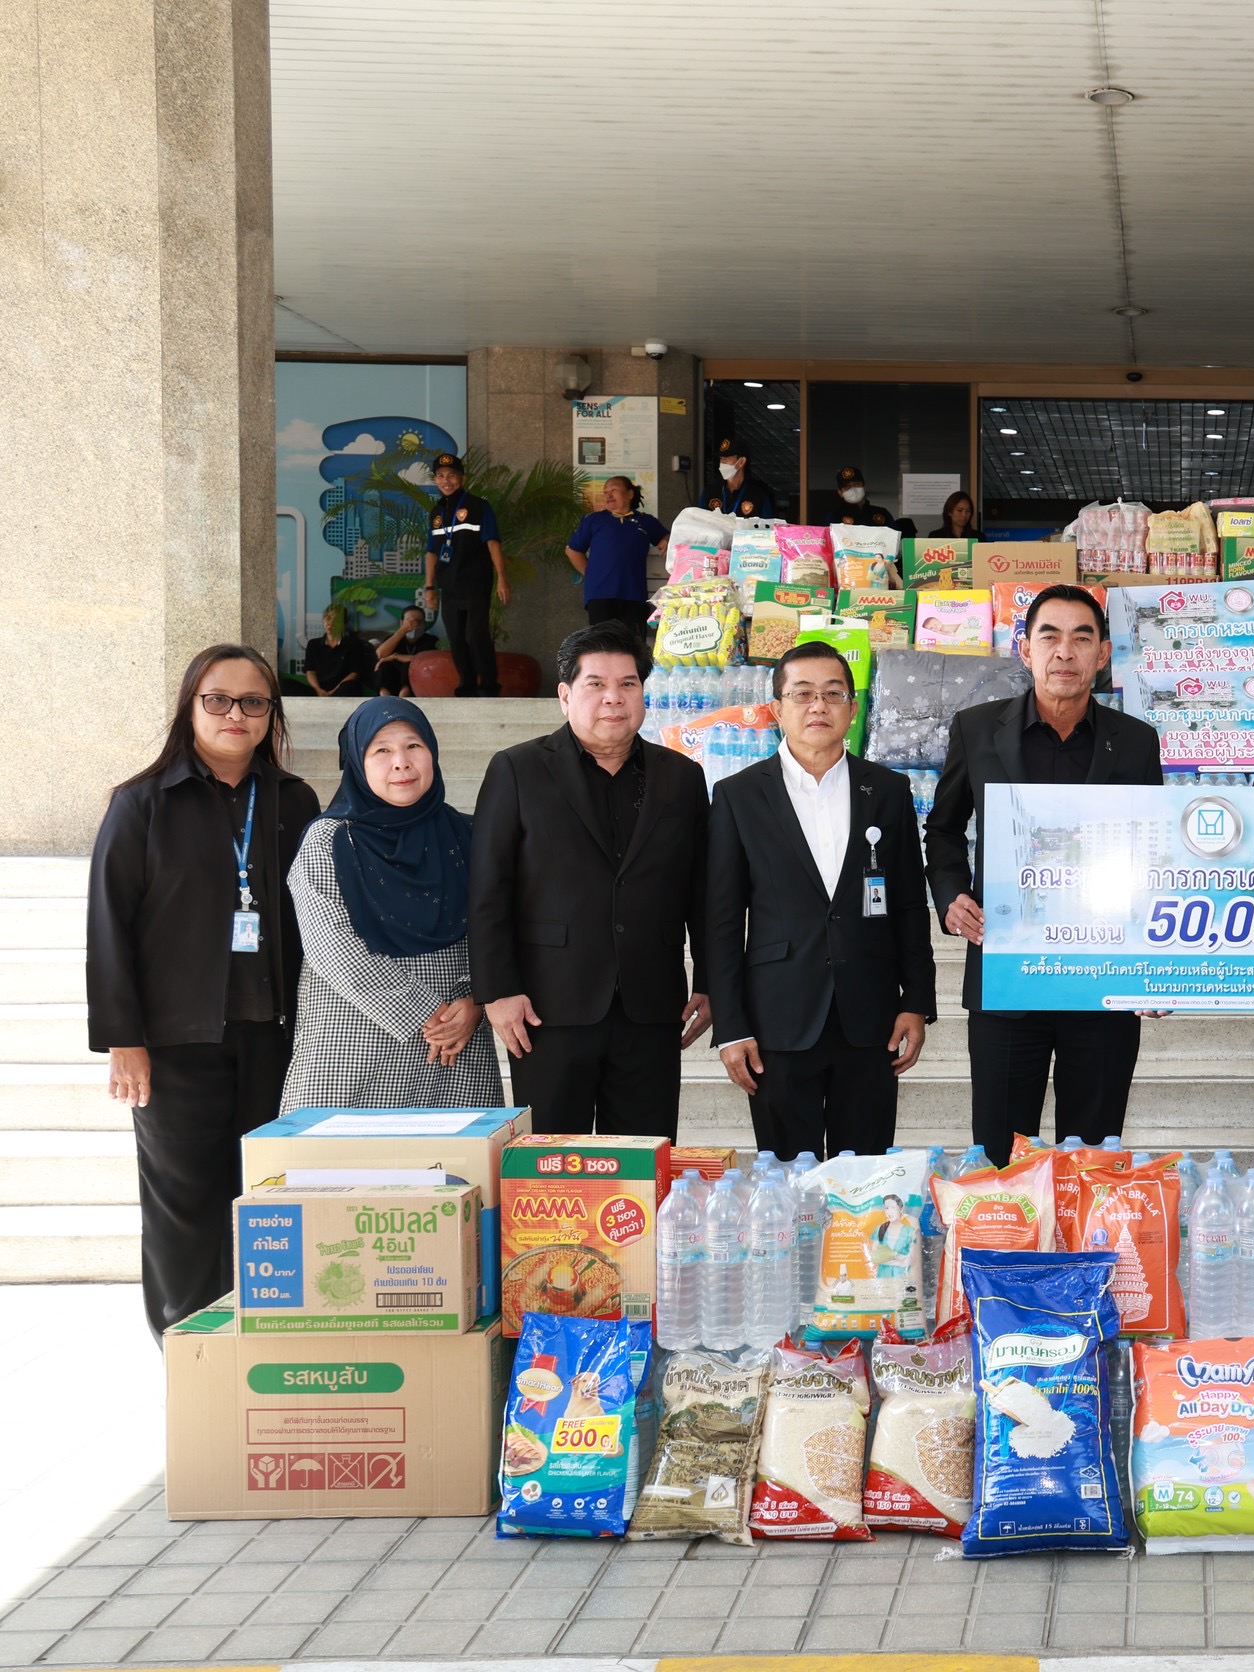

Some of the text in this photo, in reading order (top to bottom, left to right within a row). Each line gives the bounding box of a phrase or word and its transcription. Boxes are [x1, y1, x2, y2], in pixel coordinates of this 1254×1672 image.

[576, 410, 612, 418] FOR ALL
[1228, 560, 1252, 569] MINCED
[858, 595, 896, 605] MAMA
[839, 606, 865, 614] MINCED
[1044, 920, 1123, 944] มอบเงิน
[539, 1156, 618, 1172] ฟรี 3 ซอง
[513, 1198, 587, 1219] MAMA
[611, 1200, 626, 1214] ฟรี
[248, 1214, 293, 1228] ขายง่าย
[355, 1205, 438, 1234] ดัชมิลล์
[606, 1208, 637, 1227] 3 ซอง
[977, 1210, 1018, 1222] ตราฉัตร
[610, 1220, 639, 1241] คุ้มกว่า
[253, 1236, 289, 1250] กำไรดี
[1198, 1232, 1228, 1243] Ocean
[246, 1262, 274, 1278] 10
[386, 1264, 434, 1275] โปรดอย่าโยน
[422, 1278, 433, 1286] 10
[435, 1276, 448, 1287] ชั้น
[252, 1287, 279, 1299] 180
[382, 1316, 444, 1328] รสผลไม้รวม
[996, 1344, 1077, 1358] มาบุญครอง
[283, 1365, 368, 1391] รสหมูสับ
[516, 1376, 564, 1393] SmartHeart
[1072, 1384, 1099, 1396] 100%
[1200, 1391, 1239, 1401] Happy
[1179, 1402, 1198, 1416] All
[1200, 1401, 1230, 1416] Day
[562, 1419, 586, 1429] FREE
[555, 1428, 598, 1448] 300
[1158, 1489, 1195, 1502] M 74
[876, 1502, 891, 1511] 150
